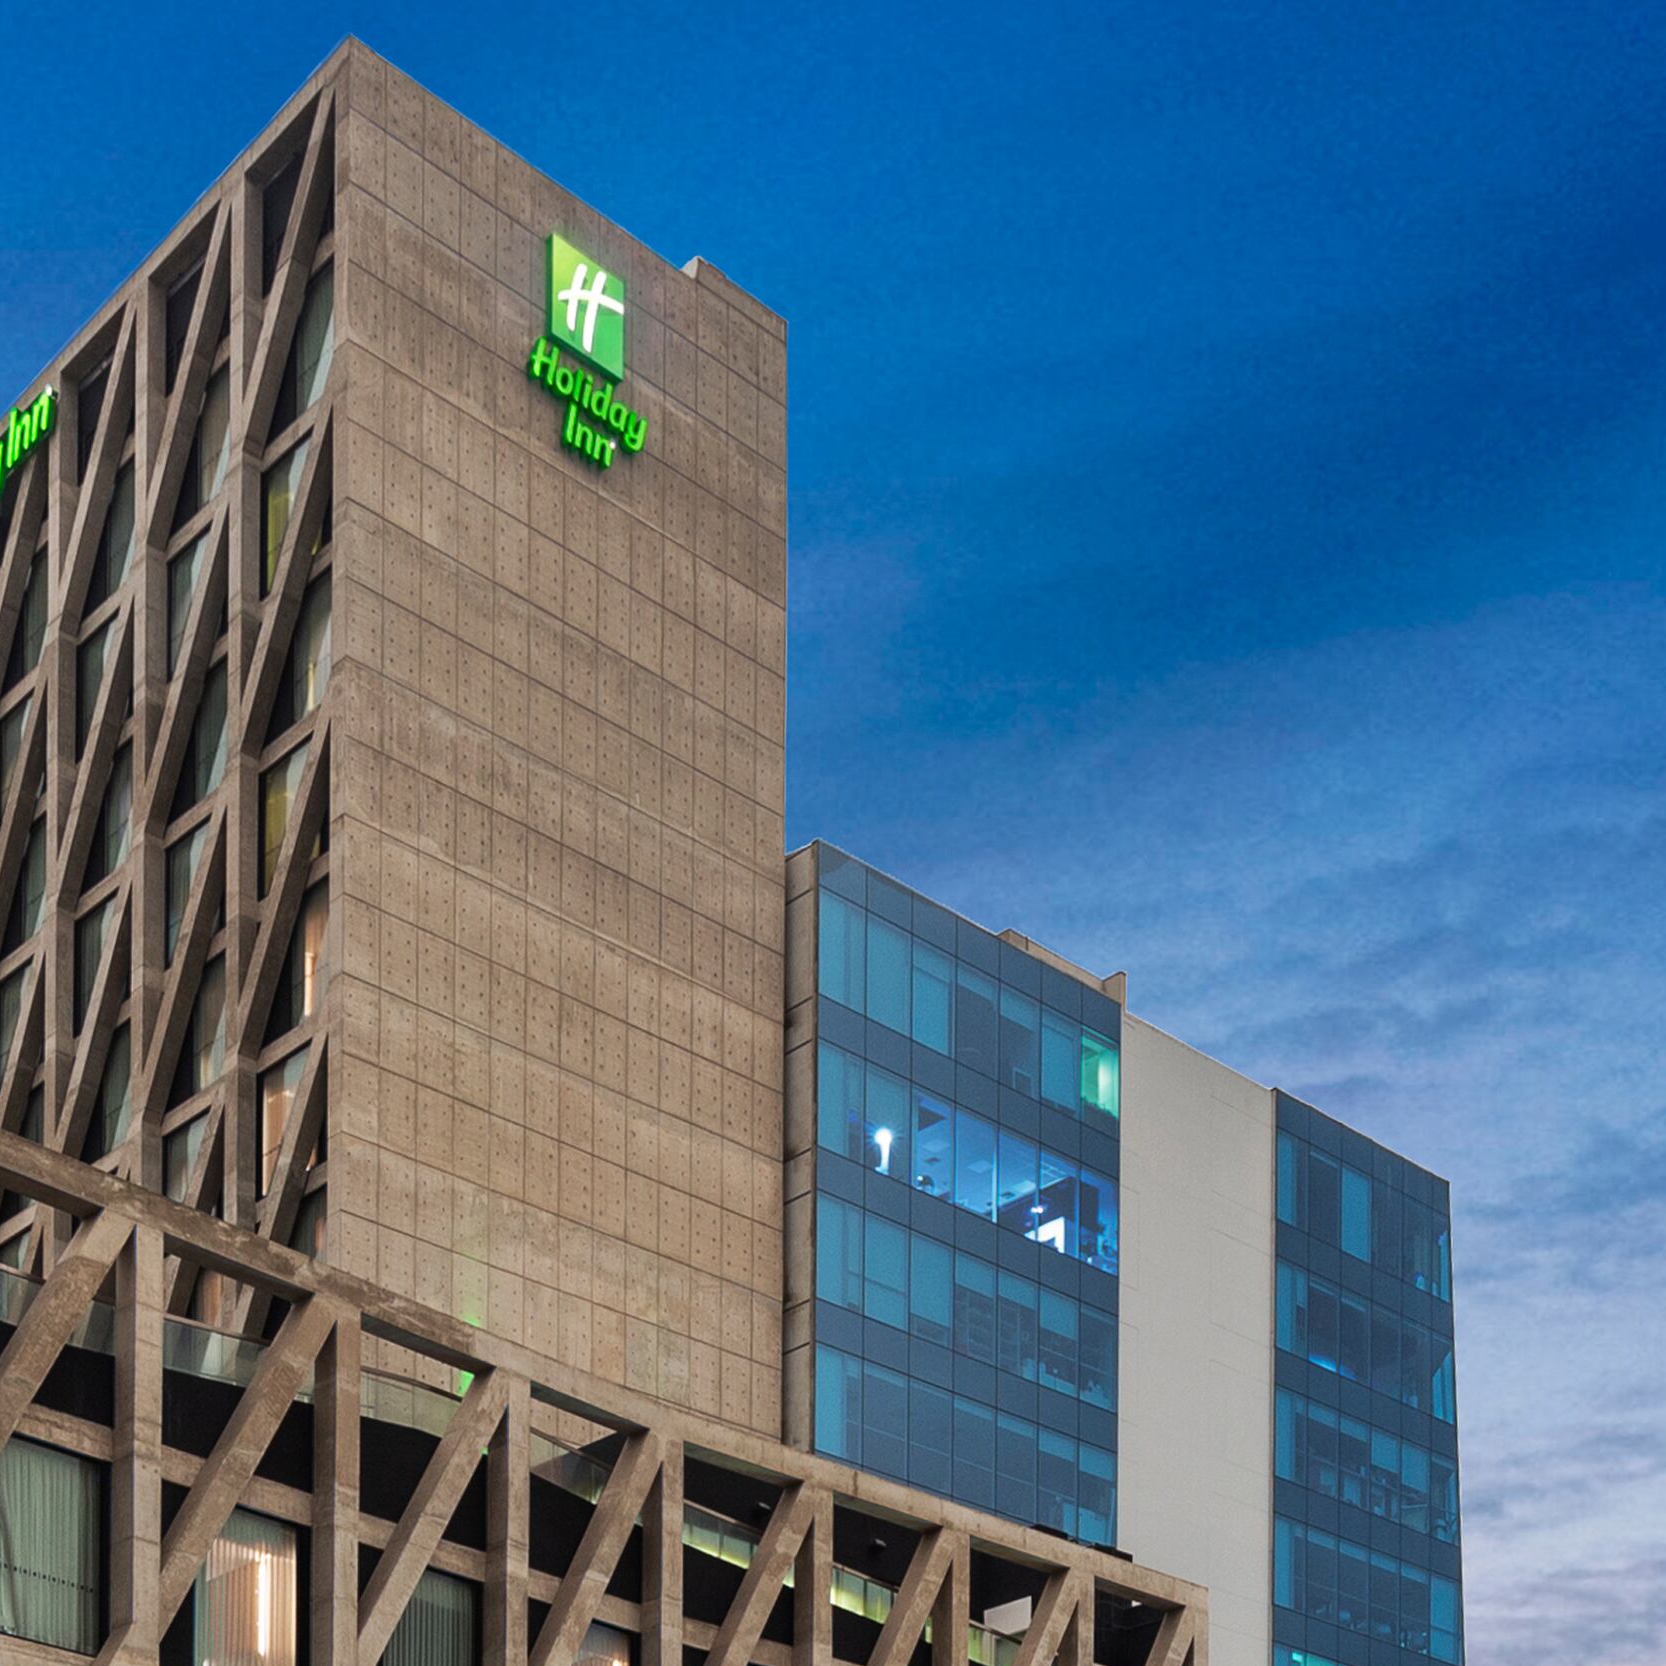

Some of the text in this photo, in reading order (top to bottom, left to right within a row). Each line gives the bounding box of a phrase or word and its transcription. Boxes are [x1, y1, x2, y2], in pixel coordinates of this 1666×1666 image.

[8, 394, 51, 468] Inn
[531, 337, 647, 451] Holiday
[565, 405, 612, 467] Inn
